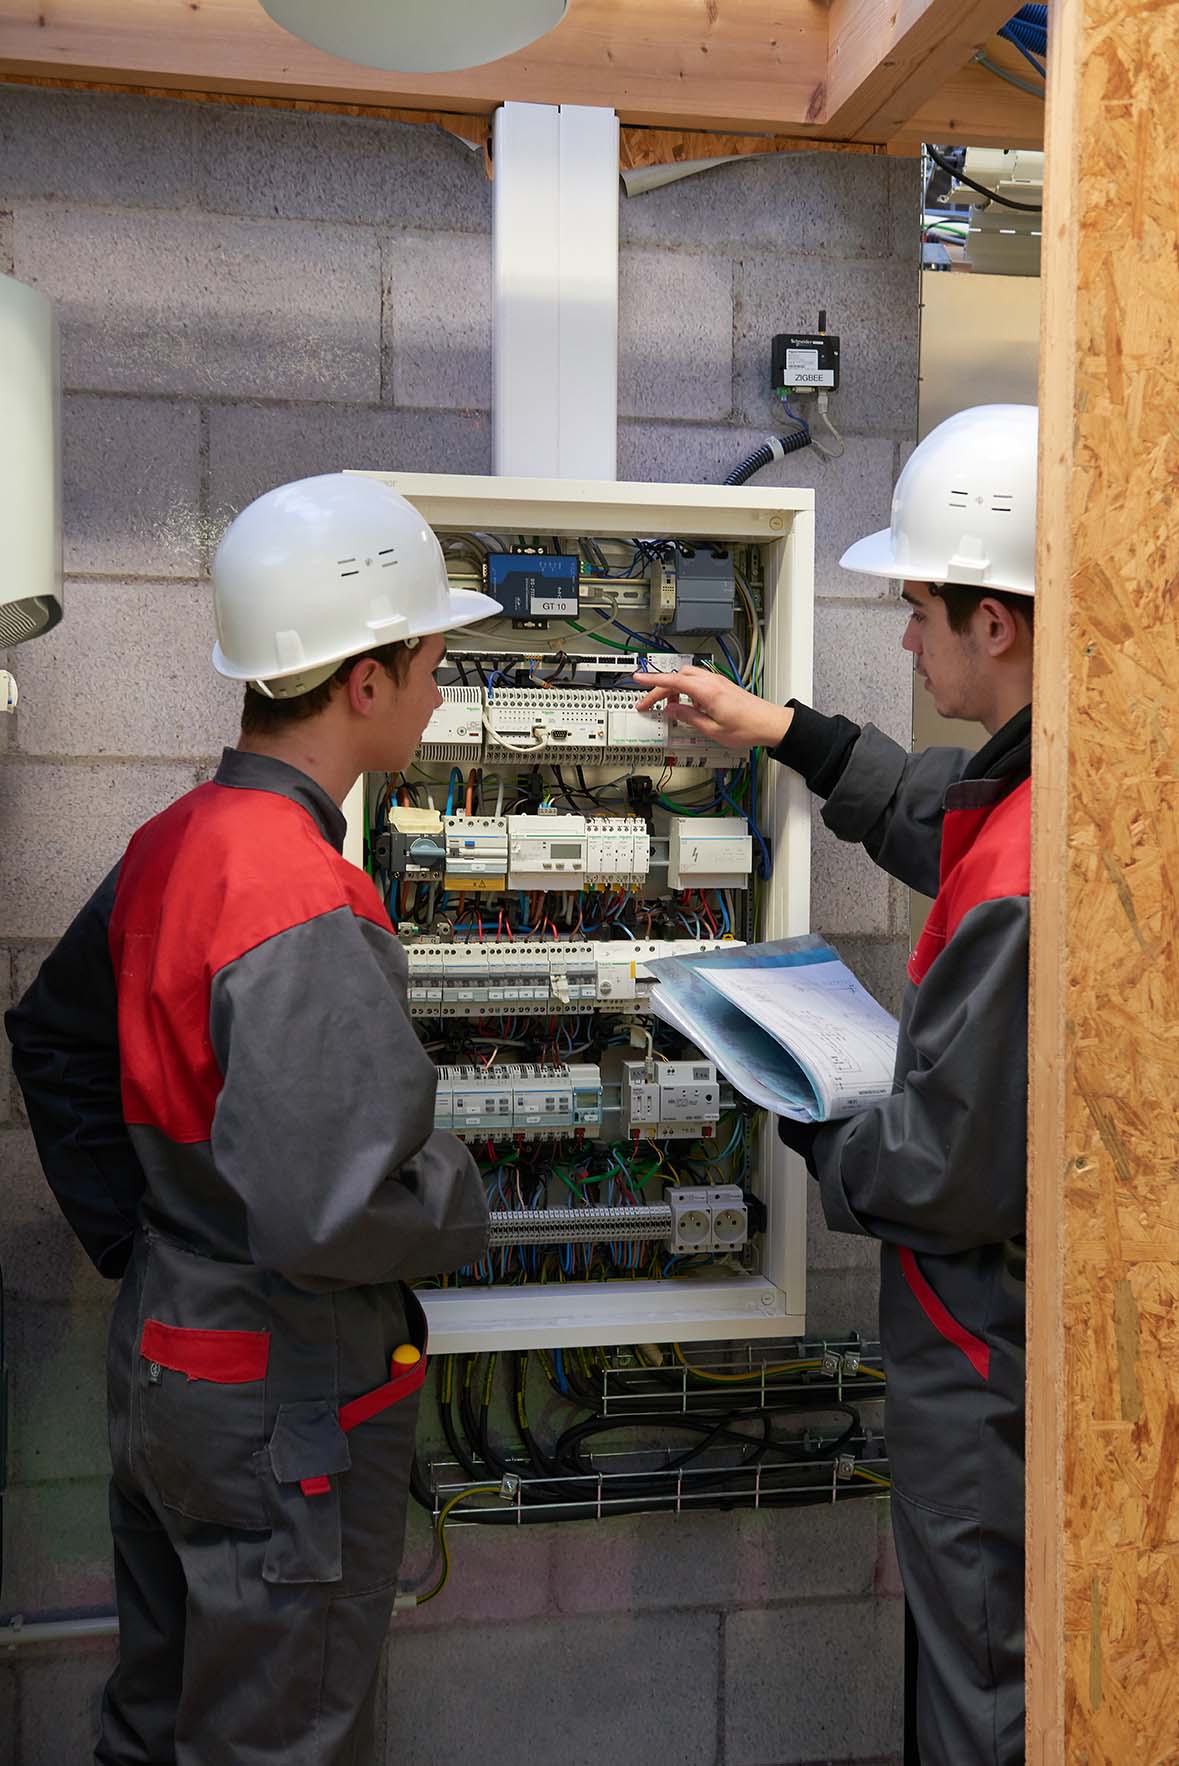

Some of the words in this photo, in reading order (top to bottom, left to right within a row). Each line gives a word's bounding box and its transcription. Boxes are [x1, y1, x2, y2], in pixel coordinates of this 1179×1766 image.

[795, 374, 824, 382] ZIGBEE
[542, 602, 555, 611] GT
[557, 602, 567, 611] 10
